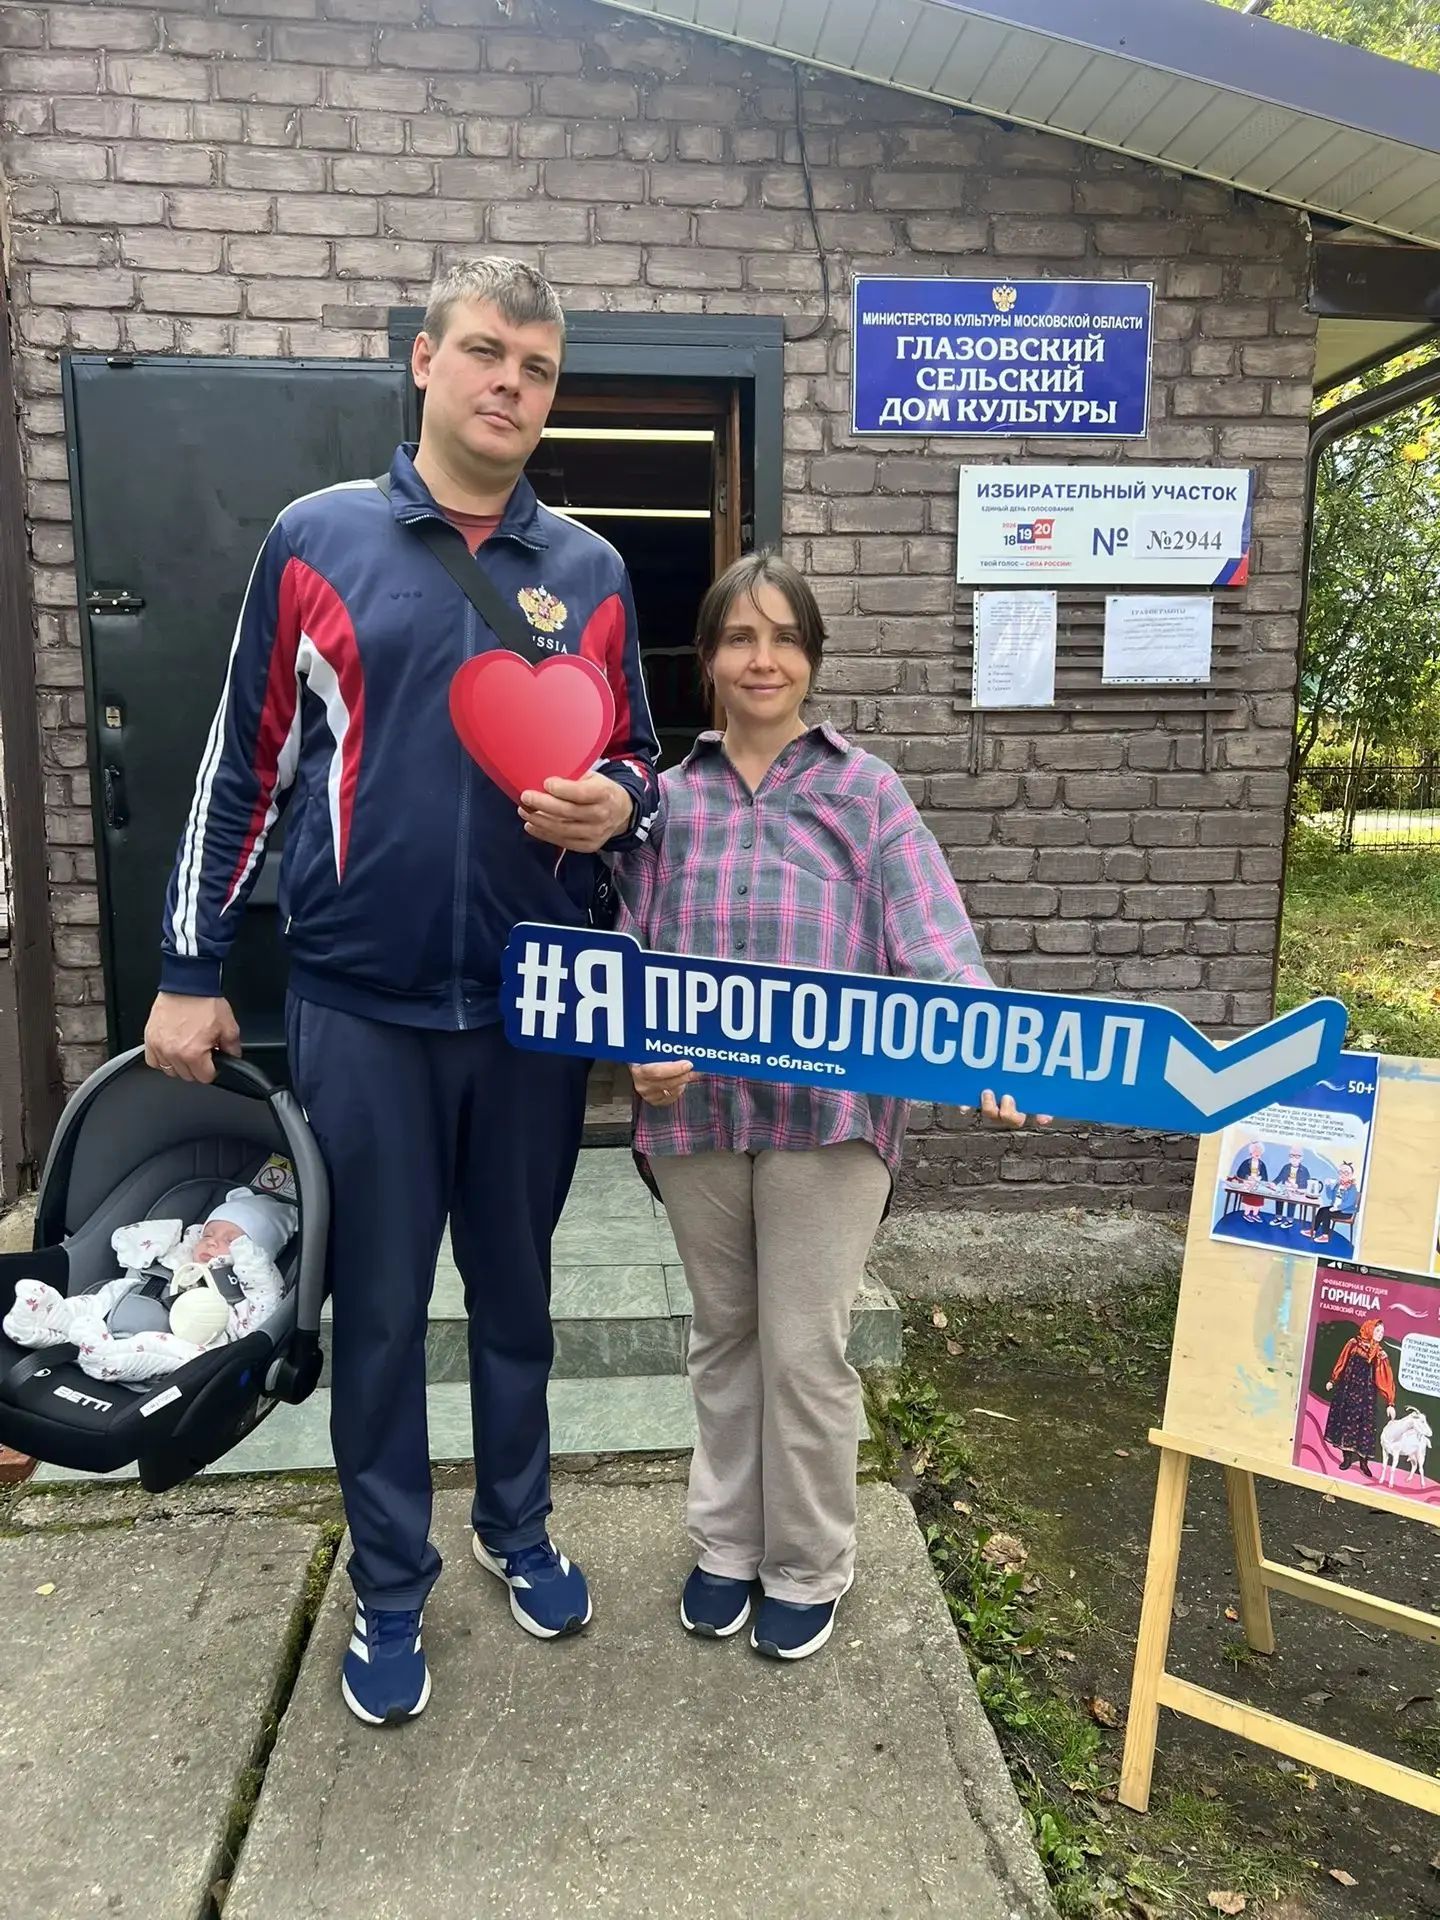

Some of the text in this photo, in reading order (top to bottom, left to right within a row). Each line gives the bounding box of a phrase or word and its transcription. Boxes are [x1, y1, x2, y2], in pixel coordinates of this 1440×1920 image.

[863, 312, 1143, 329] МИНИСТЕРСТВО КУЛЬТУРЫ МОСКОВСКОЙ ОБЛАСТИ
[896, 333, 1105, 362] ГЛАЗОВСКИЙ
[916, 364, 1084, 393] СЕЛЬСКИЙ
[879, 397, 1117, 426] ДОМ КУЛЬТУРЫ
[977, 481, 1237, 501] ИЗБИРАТЕЛЬНЫЙ УЧАСТОК
[1003, 523, 1051, 546] 18 19 20
[1092, 527, 1129, 556] №
[1146, 530, 1222, 551] №2944
[532, 635, 568, 654] SSIA
[516, 941, 1146, 1087] #Я ПРОГОЛОСОВАЛ
[645, 1038, 846, 1076] Московская область
[1347, 1080, 1375, 1095] 50+
[1320, 1285, 1381, 1311] ГОРНИЦА
